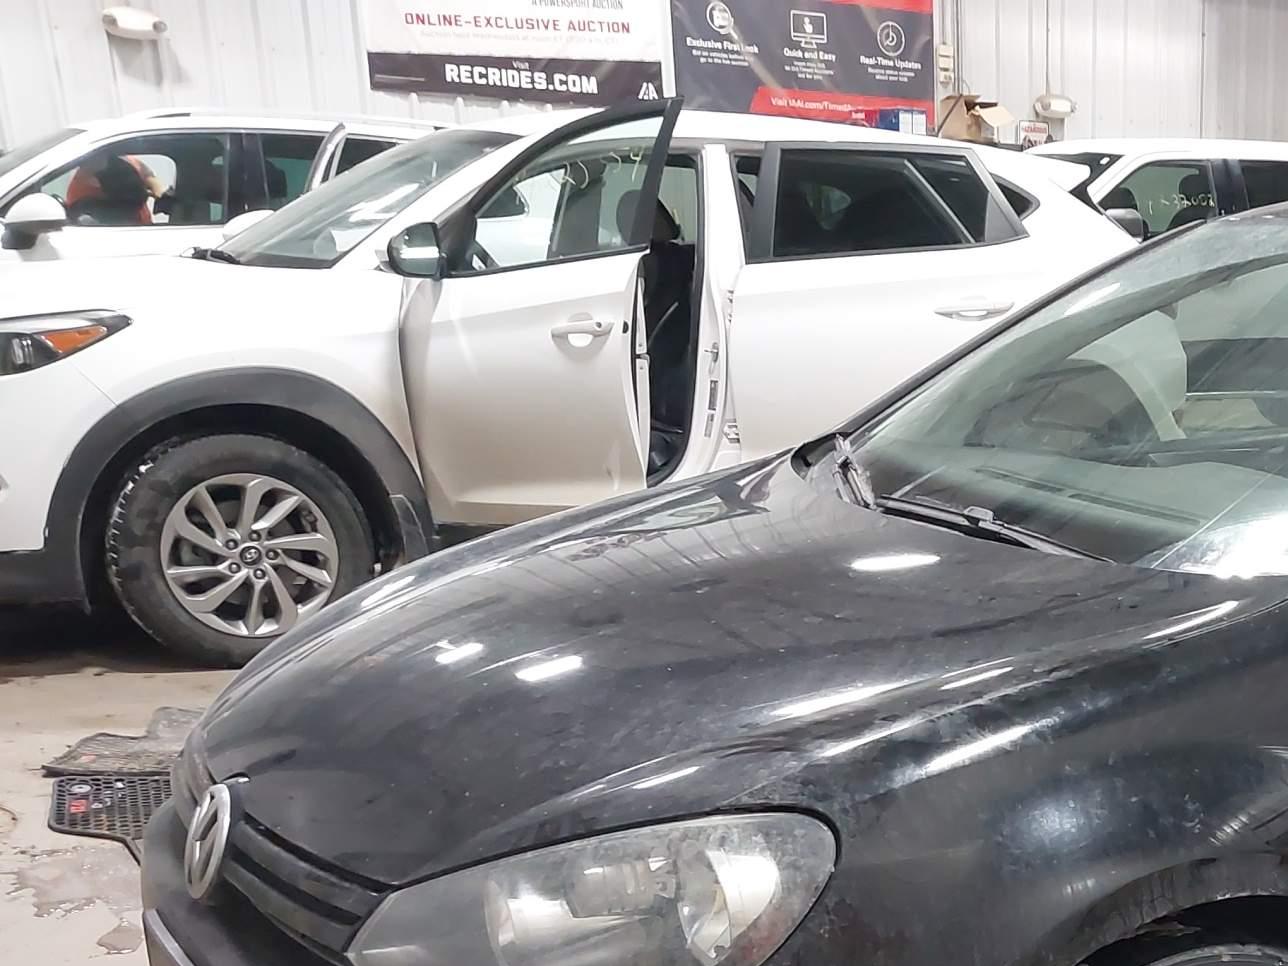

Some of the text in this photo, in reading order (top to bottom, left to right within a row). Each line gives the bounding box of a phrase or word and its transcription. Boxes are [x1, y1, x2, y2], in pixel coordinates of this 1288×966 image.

[404, 12, 631, 34] ONLINE-EXCLUSIVE AUCTION
[686, 37, 723, 50] Exclusive
[783, 47, 837, 62] Quick and Easy
[859, 55, 922, 70] Real-Time Updates
[444, 63, 598, 94] RECRIDES.COM
[771, 96, 788, 107] Visit
